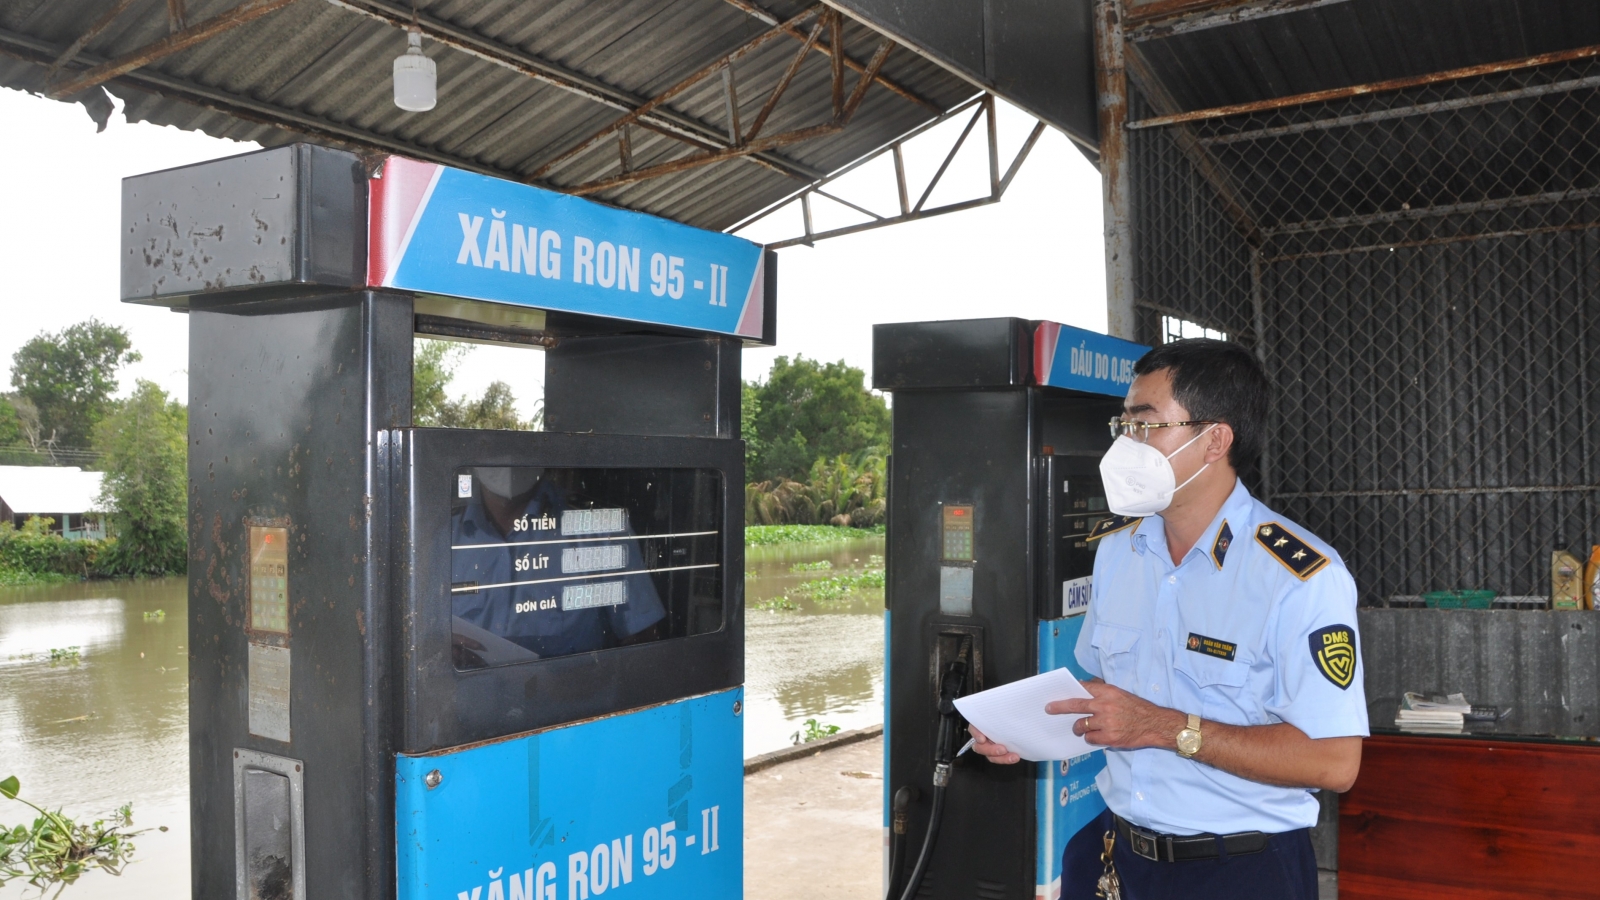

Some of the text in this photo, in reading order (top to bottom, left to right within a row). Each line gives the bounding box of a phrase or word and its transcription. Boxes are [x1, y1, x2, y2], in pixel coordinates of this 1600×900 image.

[456, 208, 728, 307] XĂNG RON 95 - II
[1095, 353, 1108, 380] DO
[514, 514, 528, 531] SỐ
[531, 513, 556, 531] TIỀN
[515, 553, 529, 571] SỐ
[533, 554, 549, 569] LÍT
[516, 600, 537, 613] ĐƠN
[540, 596, 557, 610] GIÁ
[1323, 631, 1348, 644] DMS
[457, 805, 719, 900] ĂNG RON 95 - II
